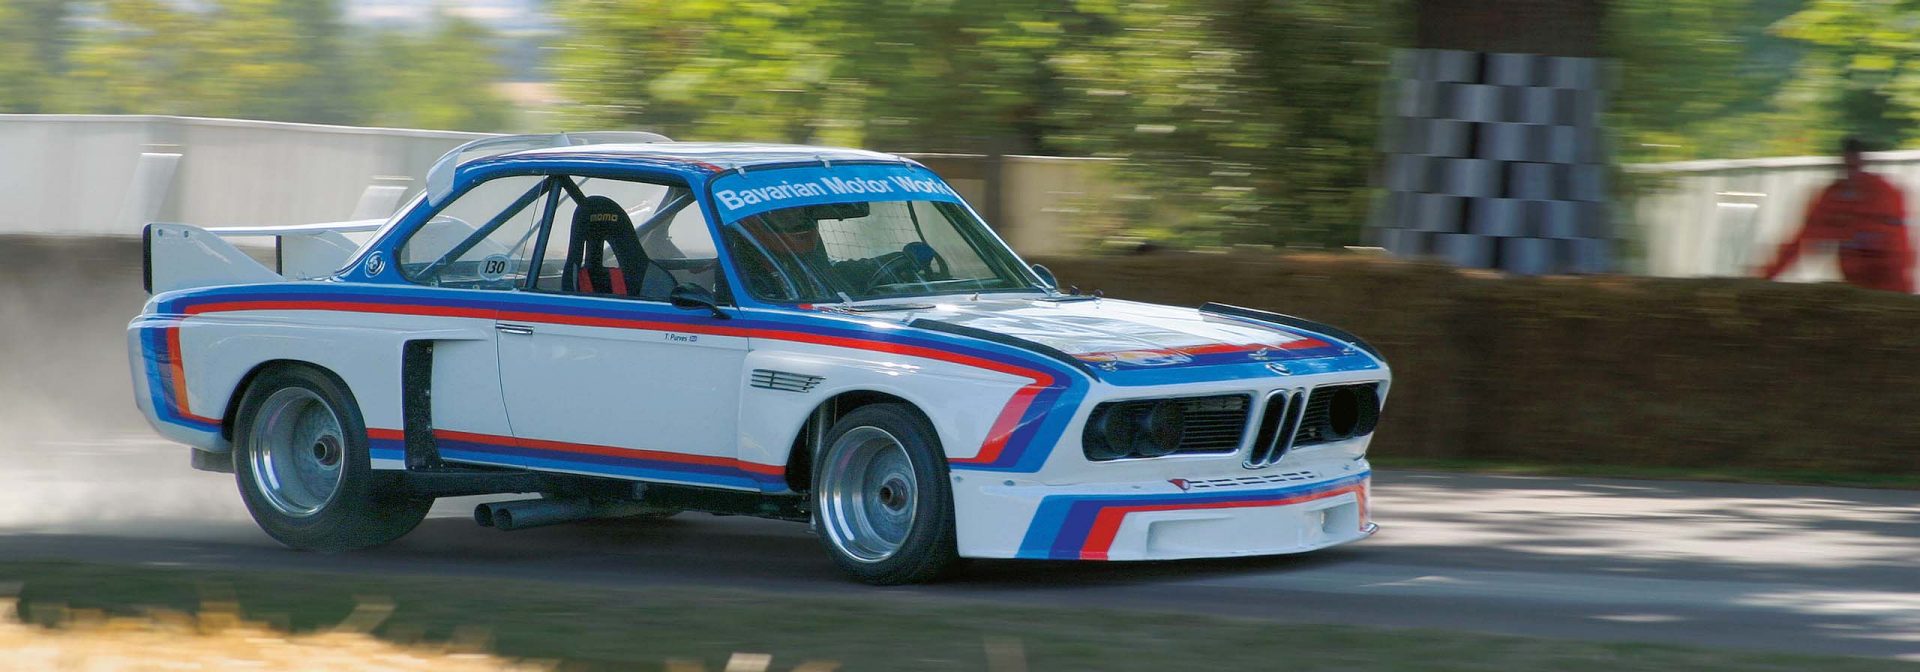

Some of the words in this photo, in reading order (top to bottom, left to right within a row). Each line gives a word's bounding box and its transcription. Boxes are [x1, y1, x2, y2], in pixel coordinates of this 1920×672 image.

[716, 181, 827, 211] Bavarian
[824, 176, 893, 196] Motor
[888, 175, 952, 196] Work
[484, 260, 505, 274] 130
